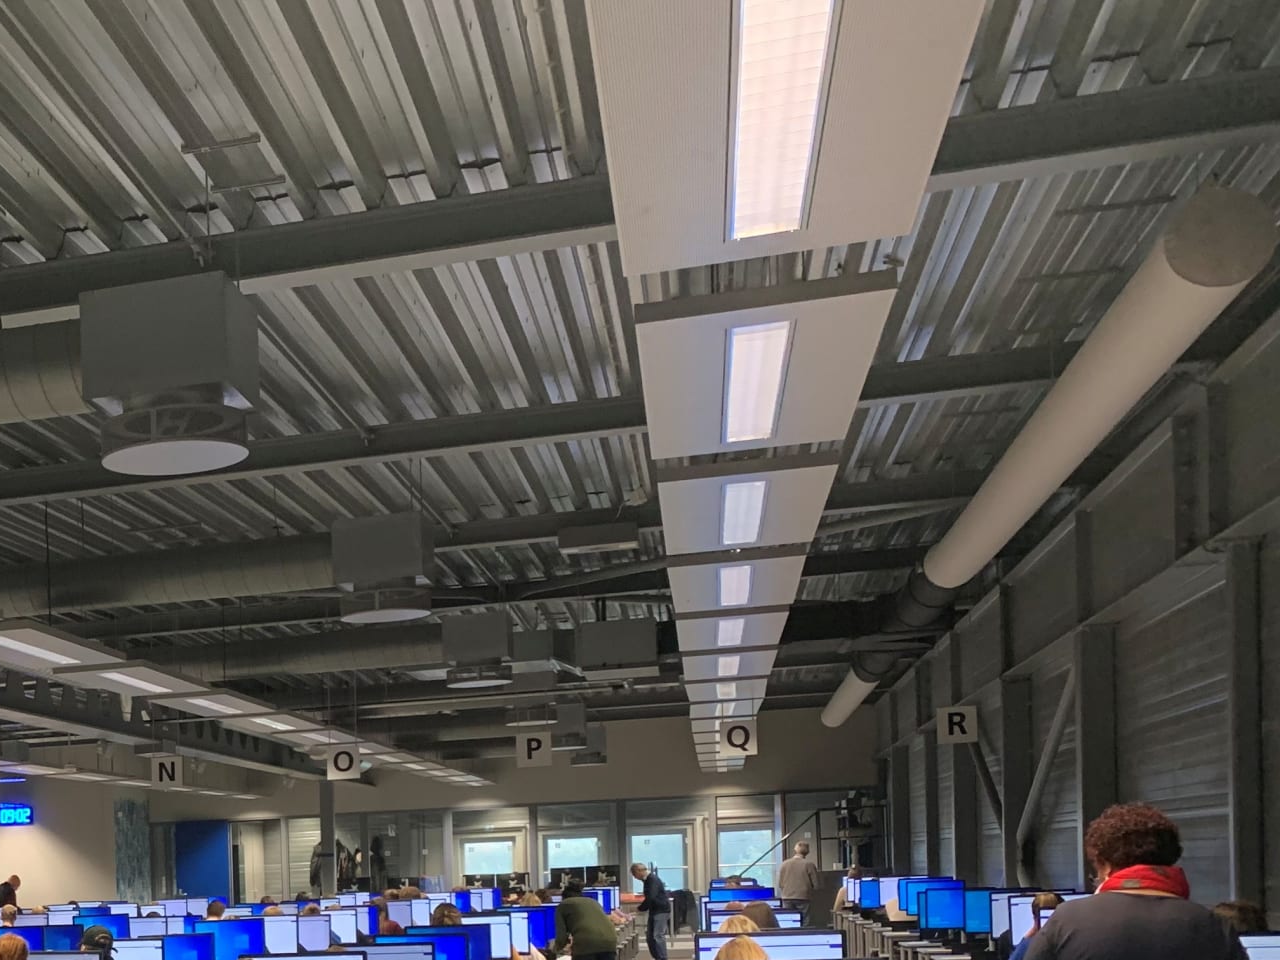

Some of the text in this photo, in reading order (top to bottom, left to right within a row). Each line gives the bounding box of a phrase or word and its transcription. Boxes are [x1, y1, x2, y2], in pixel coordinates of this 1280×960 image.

[948, 712, 968, 735] R
[526, 737, 542, 759] P
[726, 725, 750, 751] Q
[158, 761, 175, 782] N
[333, 750, 354, 772] O
